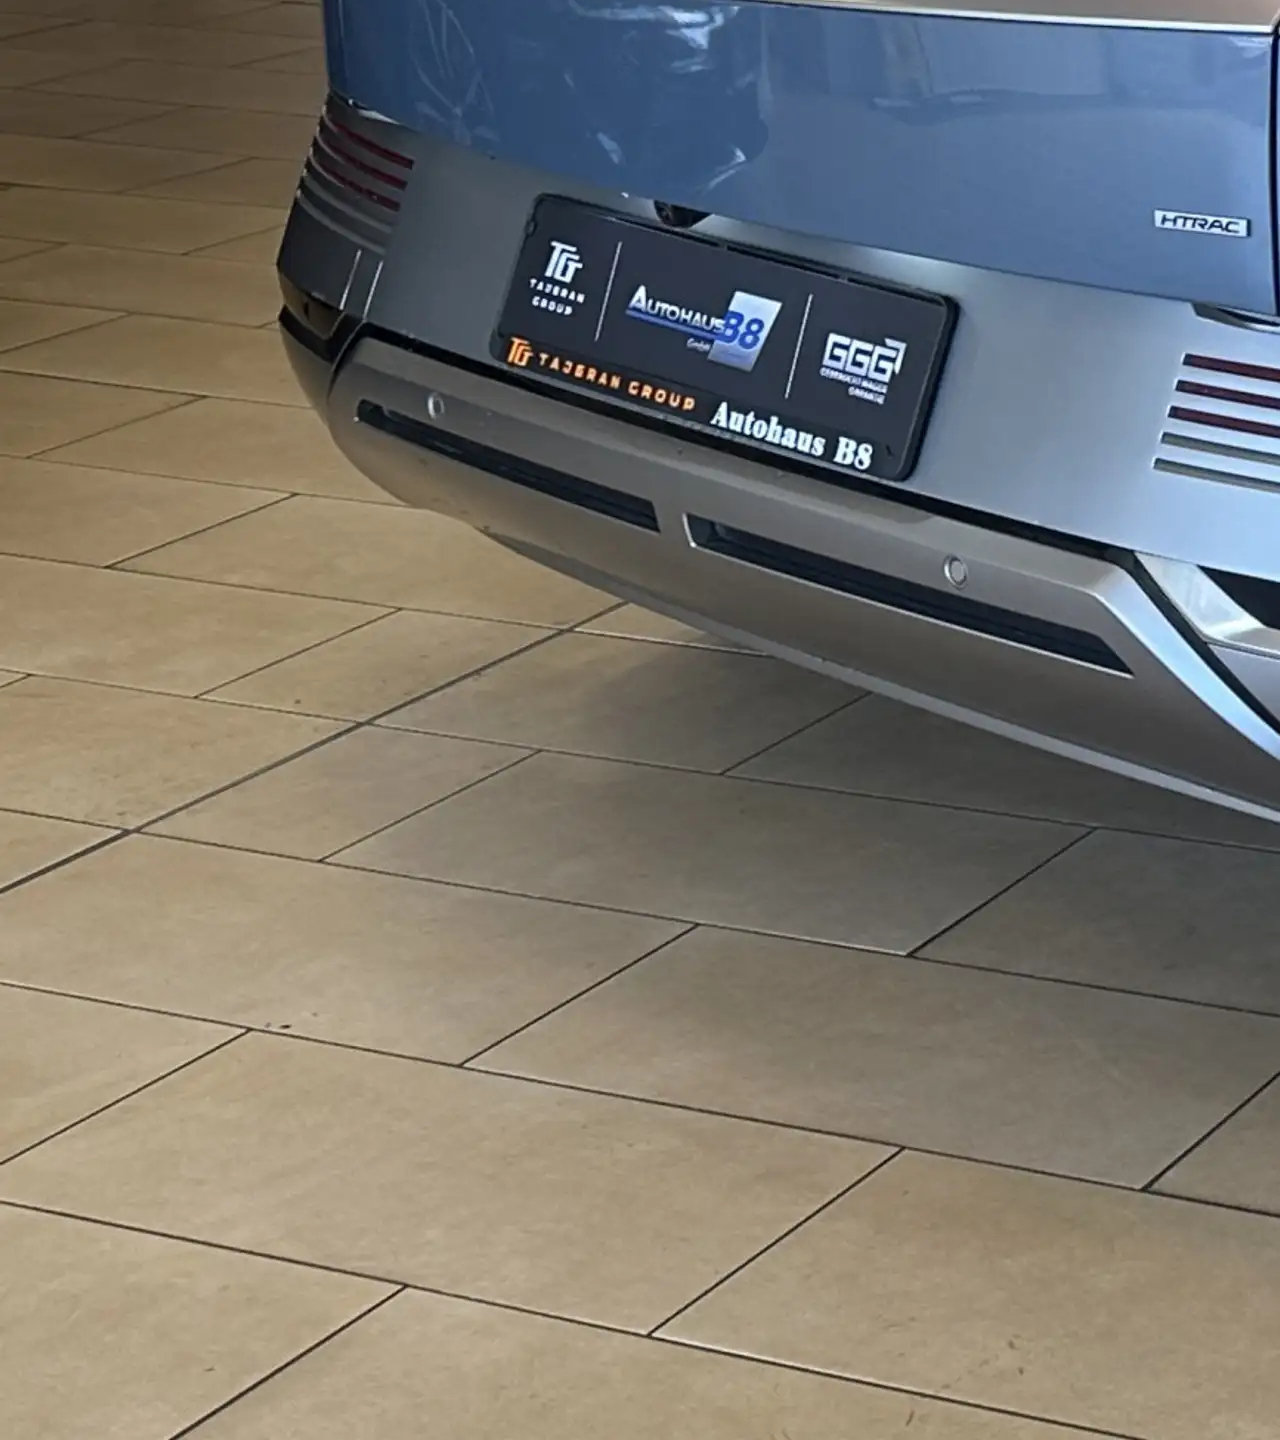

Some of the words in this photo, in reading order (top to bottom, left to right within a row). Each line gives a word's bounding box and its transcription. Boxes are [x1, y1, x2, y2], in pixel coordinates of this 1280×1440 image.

[1160, 213, 1241, 235] HTRAC
[531, 295, 573, 316] GROUP
[719, 310, 765, 350] B8
[822, 332, 908, 384] GGG
[538, 352, 622, 389] TAJERAN
[627, 380, 696, 411] GROUP
[709, 401, 827, 457] Autohaus
[833, 436, 874, 470] B8
